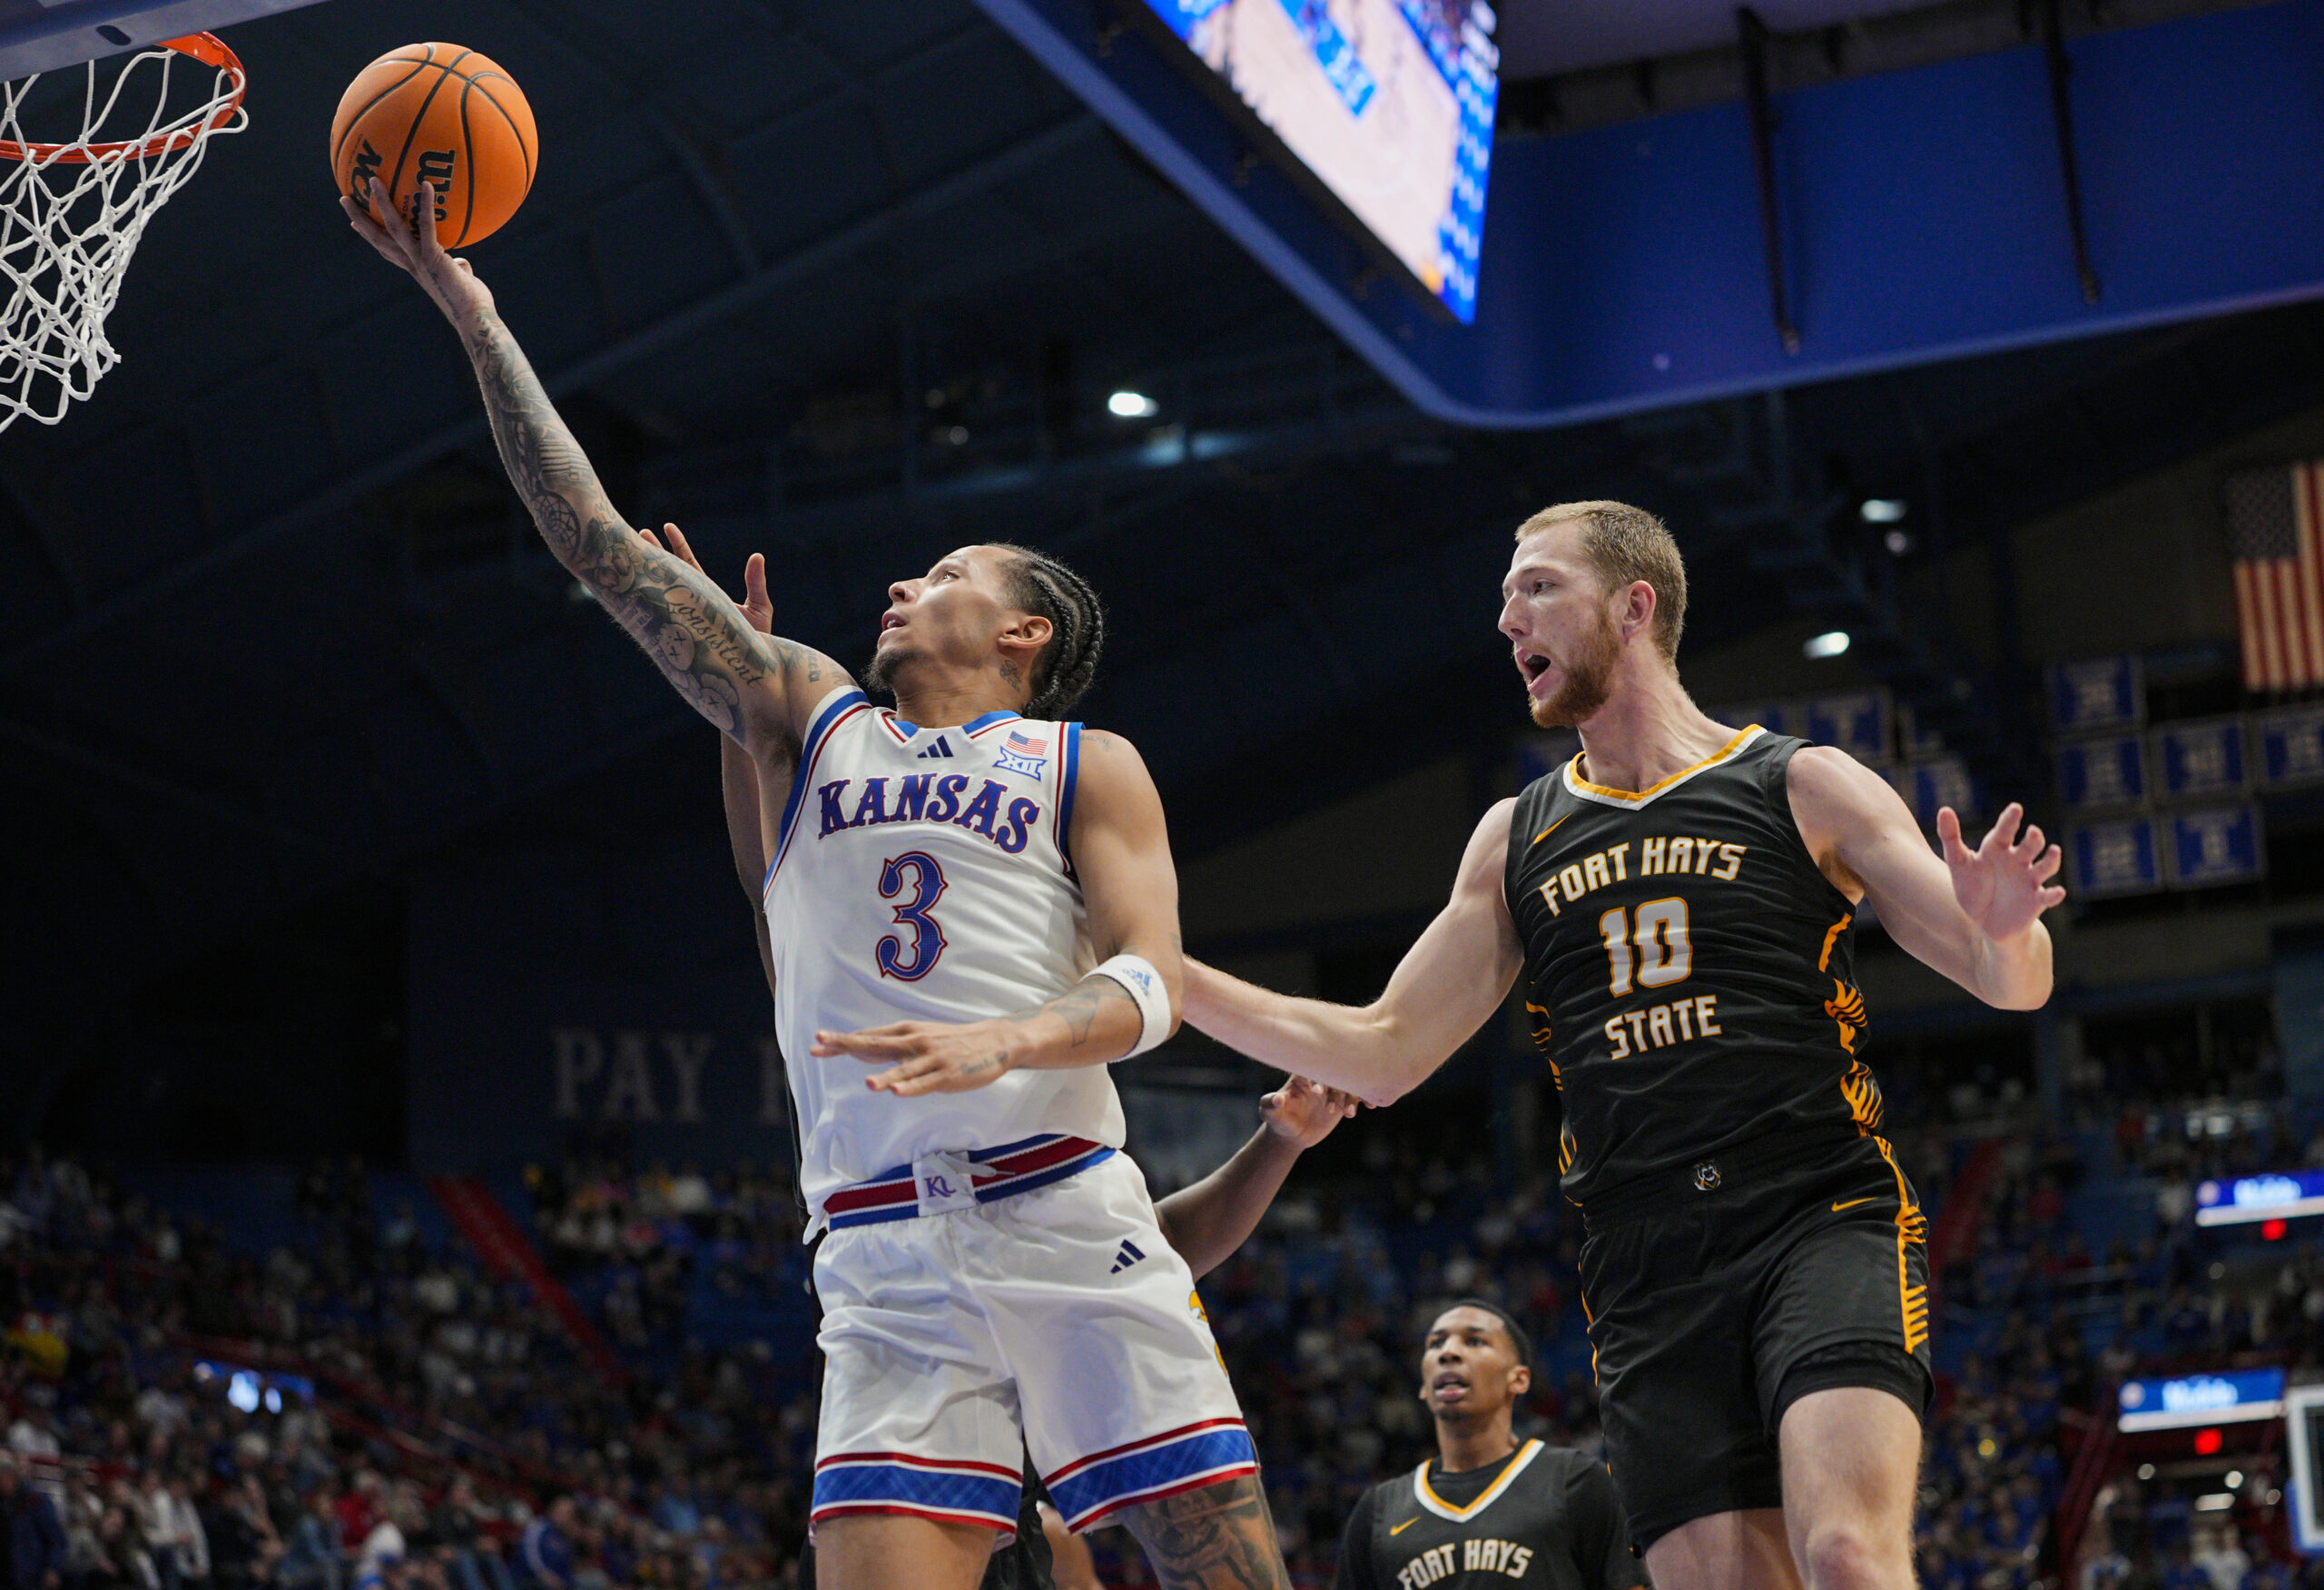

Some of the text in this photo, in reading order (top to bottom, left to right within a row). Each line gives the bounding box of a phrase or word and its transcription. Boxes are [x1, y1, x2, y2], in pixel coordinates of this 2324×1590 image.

[664, 584, 764, 690] Consistent
[818, 772, 1040, 854] KANSAS
[875, 850, 949, 982] 3
[1539, 836, 1748, 918] FORT HAYS
[1599, 896, 1694, 998] 10
[1604, 995, 1722, 1061] STATE
[551, 1026, 714, 1124] PAY
[1396, 1538, 1534, 1590] FORT HAYS
